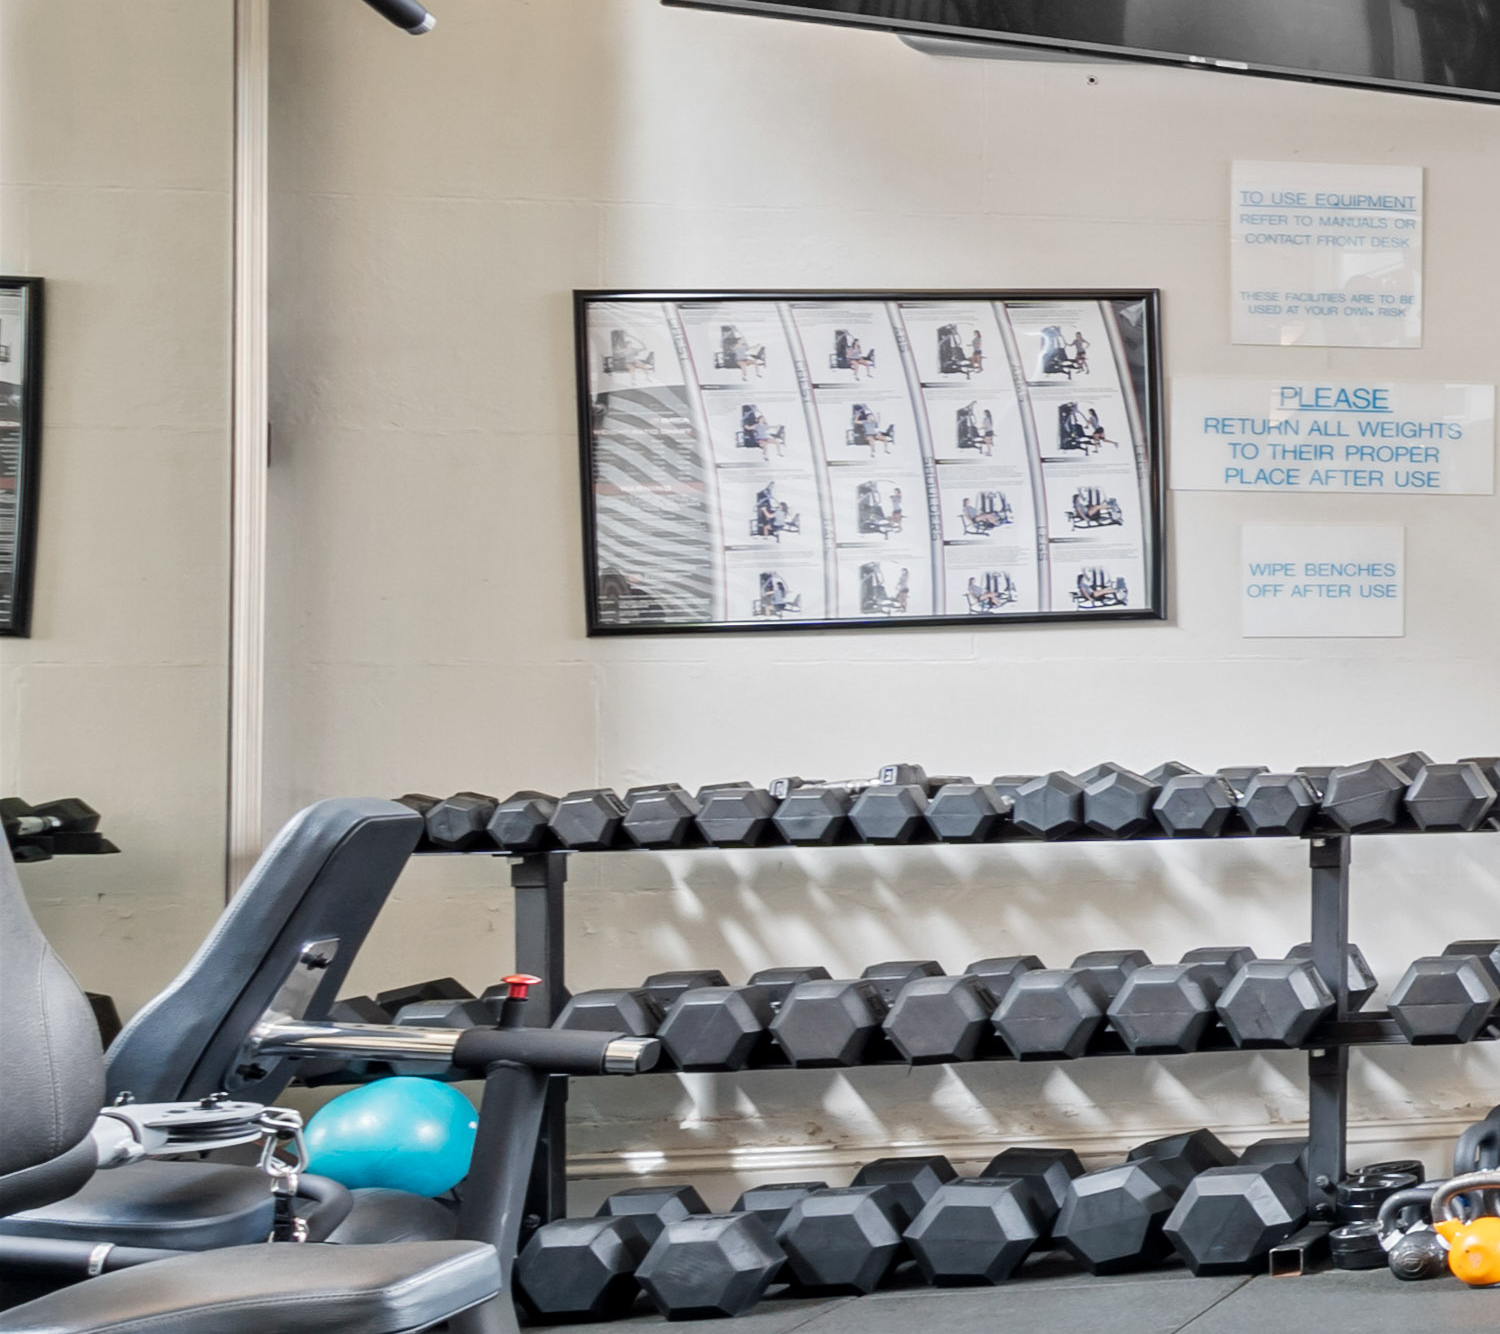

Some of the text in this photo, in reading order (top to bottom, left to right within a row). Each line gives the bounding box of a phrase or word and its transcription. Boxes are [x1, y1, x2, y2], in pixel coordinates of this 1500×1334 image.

[1240, 190, 1416, 209] TO USE EQUIPMENT
[1240, 213, 1416, 229] REFER TO MANUALS OR
[1244, 233, 1410, 248] CONTACT FRONT DESK
[1240, 291, 1415, 305] THESE FACILITIES ARE TO BE
[1248, 305, 1407, 317] USED AT YOUR OWN RISK
[1280, 386, 1390, 410] PLEASE
[1204, 417, 1462, 440] RETURN ALL WEIGHTS
[1228, 442, 1440, 464] TO THEIR PROPER
[1224, 467, 1441, 488] PLACE AFTER USE
[1249, 563, 1396, 577] WIPE BENCHES
[1247, 584, 1398, 598] OFF AFTER USE
